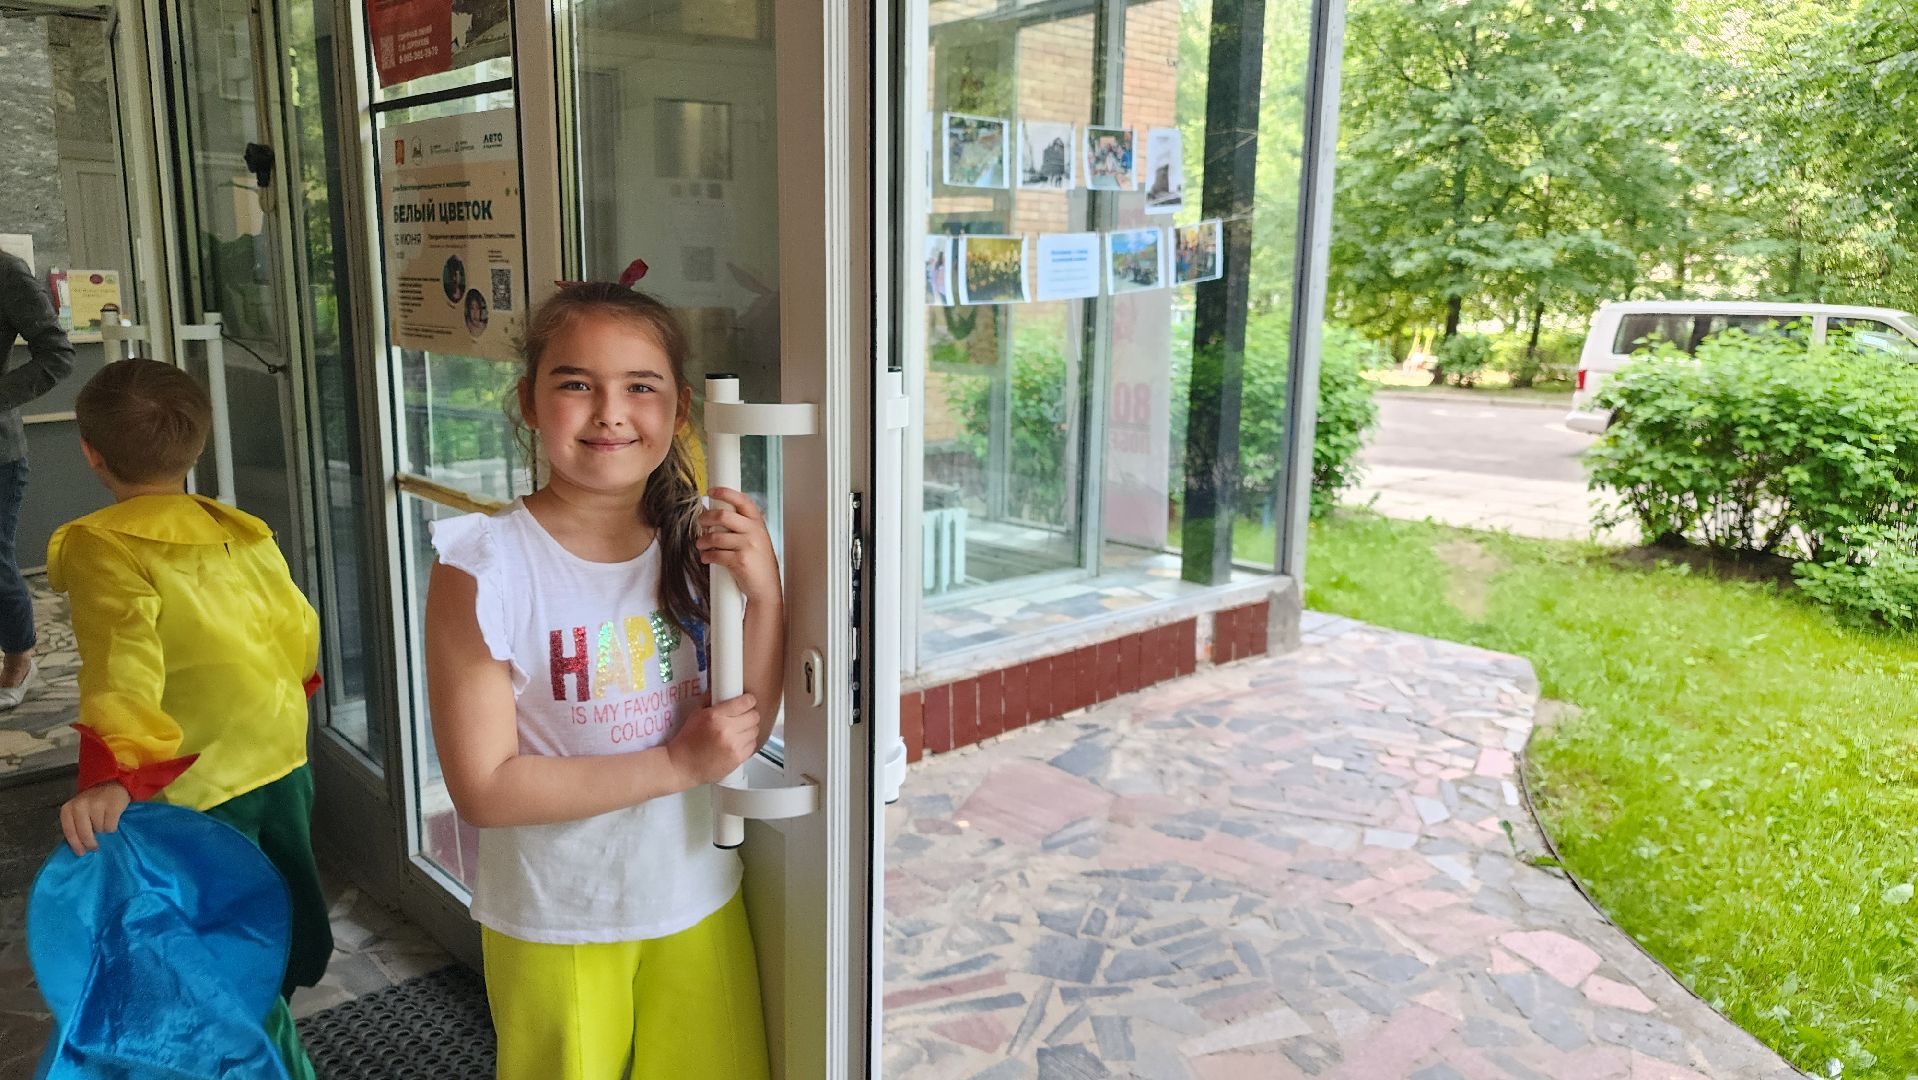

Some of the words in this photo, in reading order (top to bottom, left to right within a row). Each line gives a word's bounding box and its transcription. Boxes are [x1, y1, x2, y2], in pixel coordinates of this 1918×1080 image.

[393, 199, 435, 223] БЕЛЫЙ
[439, 200, 493, 224] ЦВЕТОК
[571, 706, 587, 725] IS
[594, 703, 619, 724] MY
[624, 679, 700, 717] FAVOURITE
[610, 710, 672, 743] COLOUR
